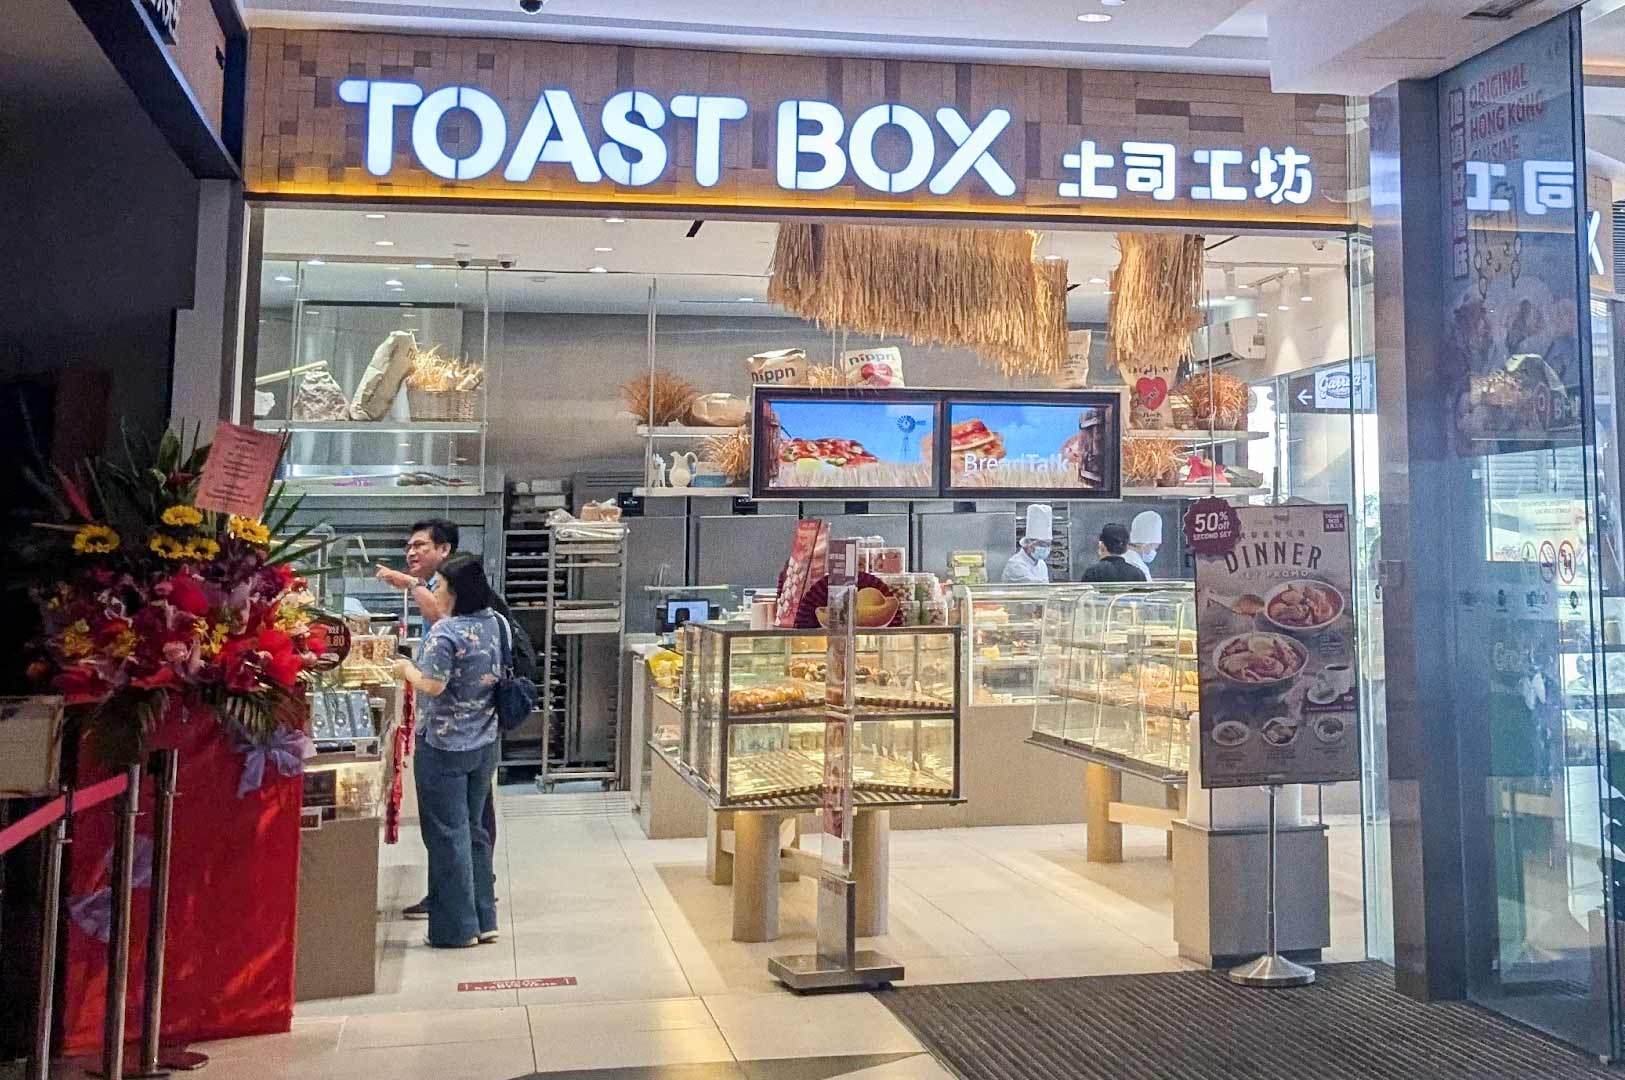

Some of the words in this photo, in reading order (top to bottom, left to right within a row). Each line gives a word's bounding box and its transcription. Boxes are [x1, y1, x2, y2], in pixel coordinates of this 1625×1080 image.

[1469, 63, 1529, 107] ORIGINAL
[338, 79, 749, 187] TOAST
[776, 100, 1017, 197] BOX
[1470, 106, 1505, 142] HONG
[1058, 140, 1315, 206] 土司工坊
[751, 366, 796, 384] nippn
[849, 353, 896, 366] nippn
[1194, 511, 1229, 533] 50%
[1217, 520, 1231, 531] off
[1224, 541, 1322, 575] DINNER
